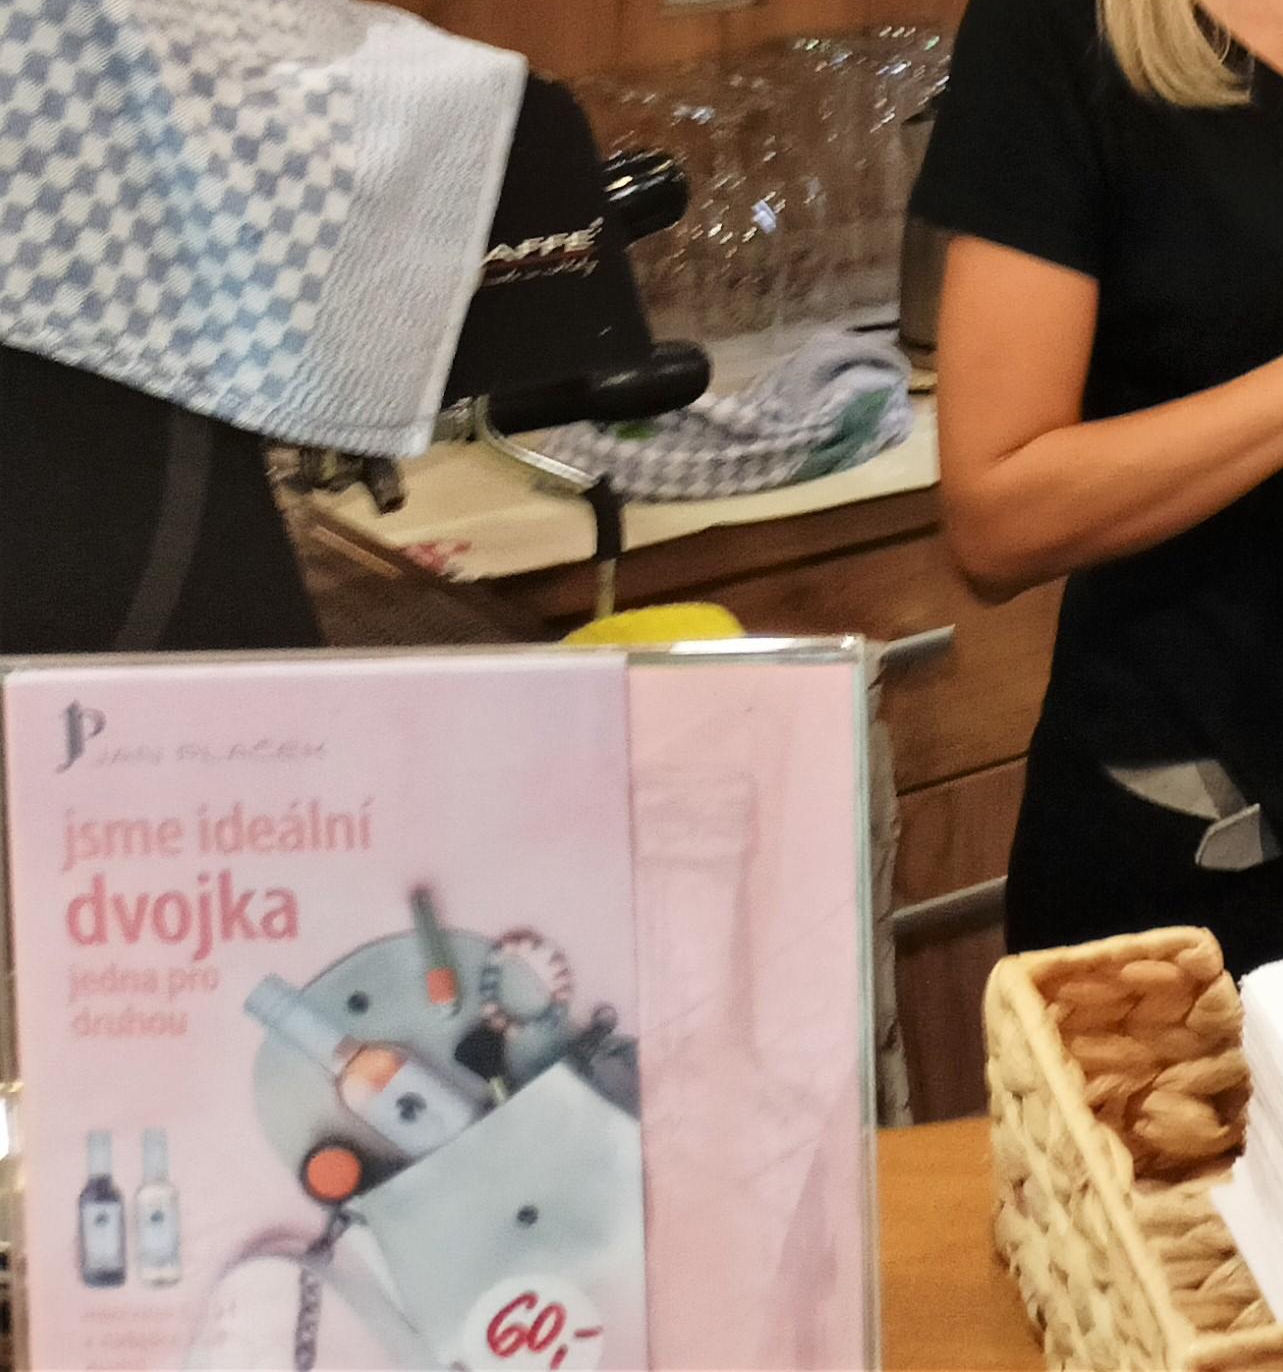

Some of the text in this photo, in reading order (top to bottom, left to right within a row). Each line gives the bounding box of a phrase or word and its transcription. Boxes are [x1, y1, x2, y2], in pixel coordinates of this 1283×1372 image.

[61, 796, 374, 871] jsme ideální
[64, 869, 299, 962] dvojka
[166, 966, 219, 1003] pro
